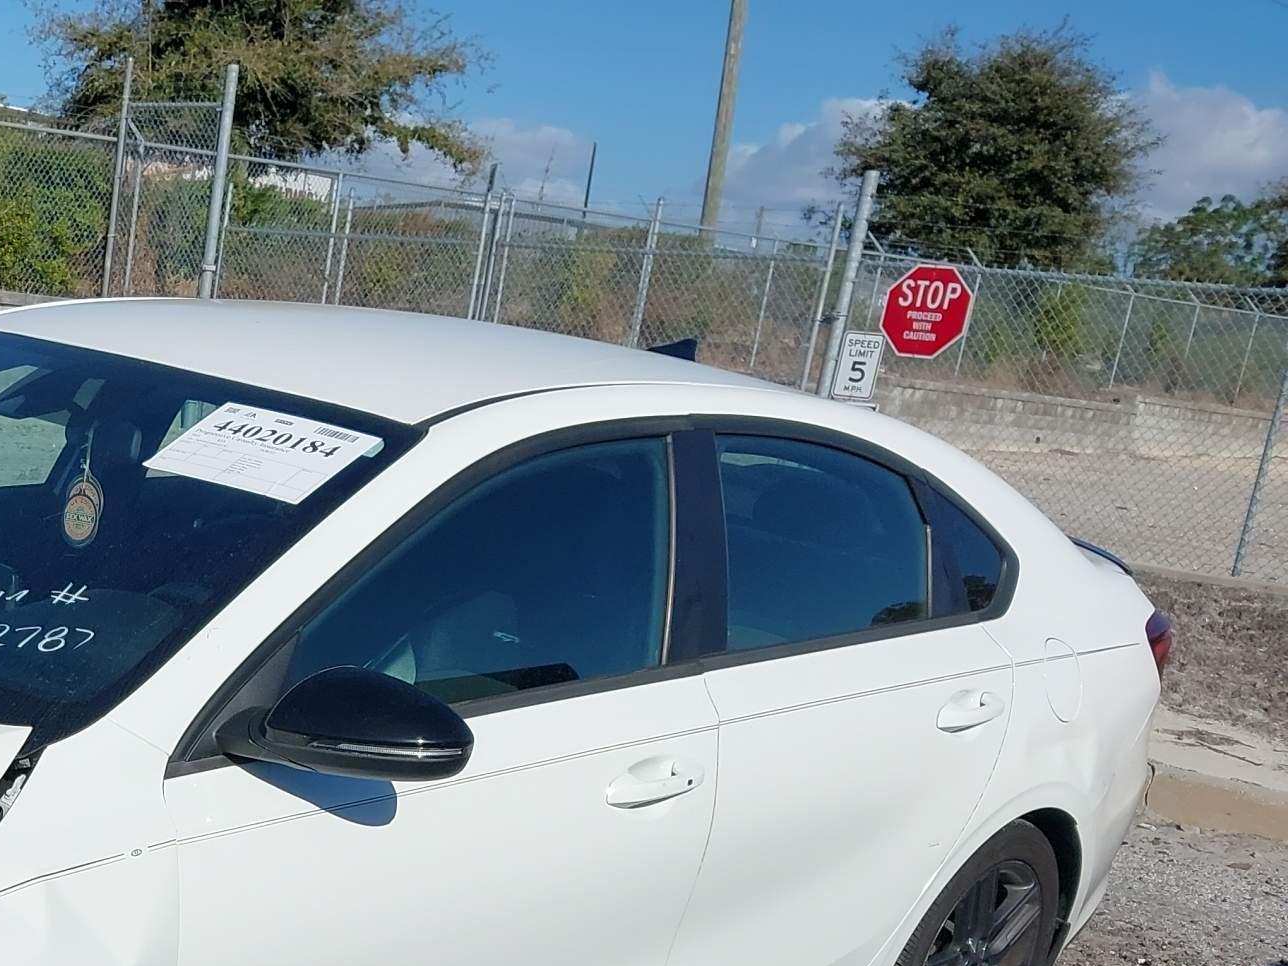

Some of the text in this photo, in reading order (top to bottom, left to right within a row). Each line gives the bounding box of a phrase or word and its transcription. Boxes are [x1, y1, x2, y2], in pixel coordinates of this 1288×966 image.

[898, 279, 962, 310] STOP
[906, 310, 943, 322] PROCEED
[912, 322, 932, 331] WITH
[903, 331, 937, 342] CAUTION
[847, 338, 881, 350] SPEED
[848, 348, 875, 359] LIMIT
[848, 361, 867, 383] 5
[213, 419, 342, 458] 44020184
[50, 582, 89, 605] #
